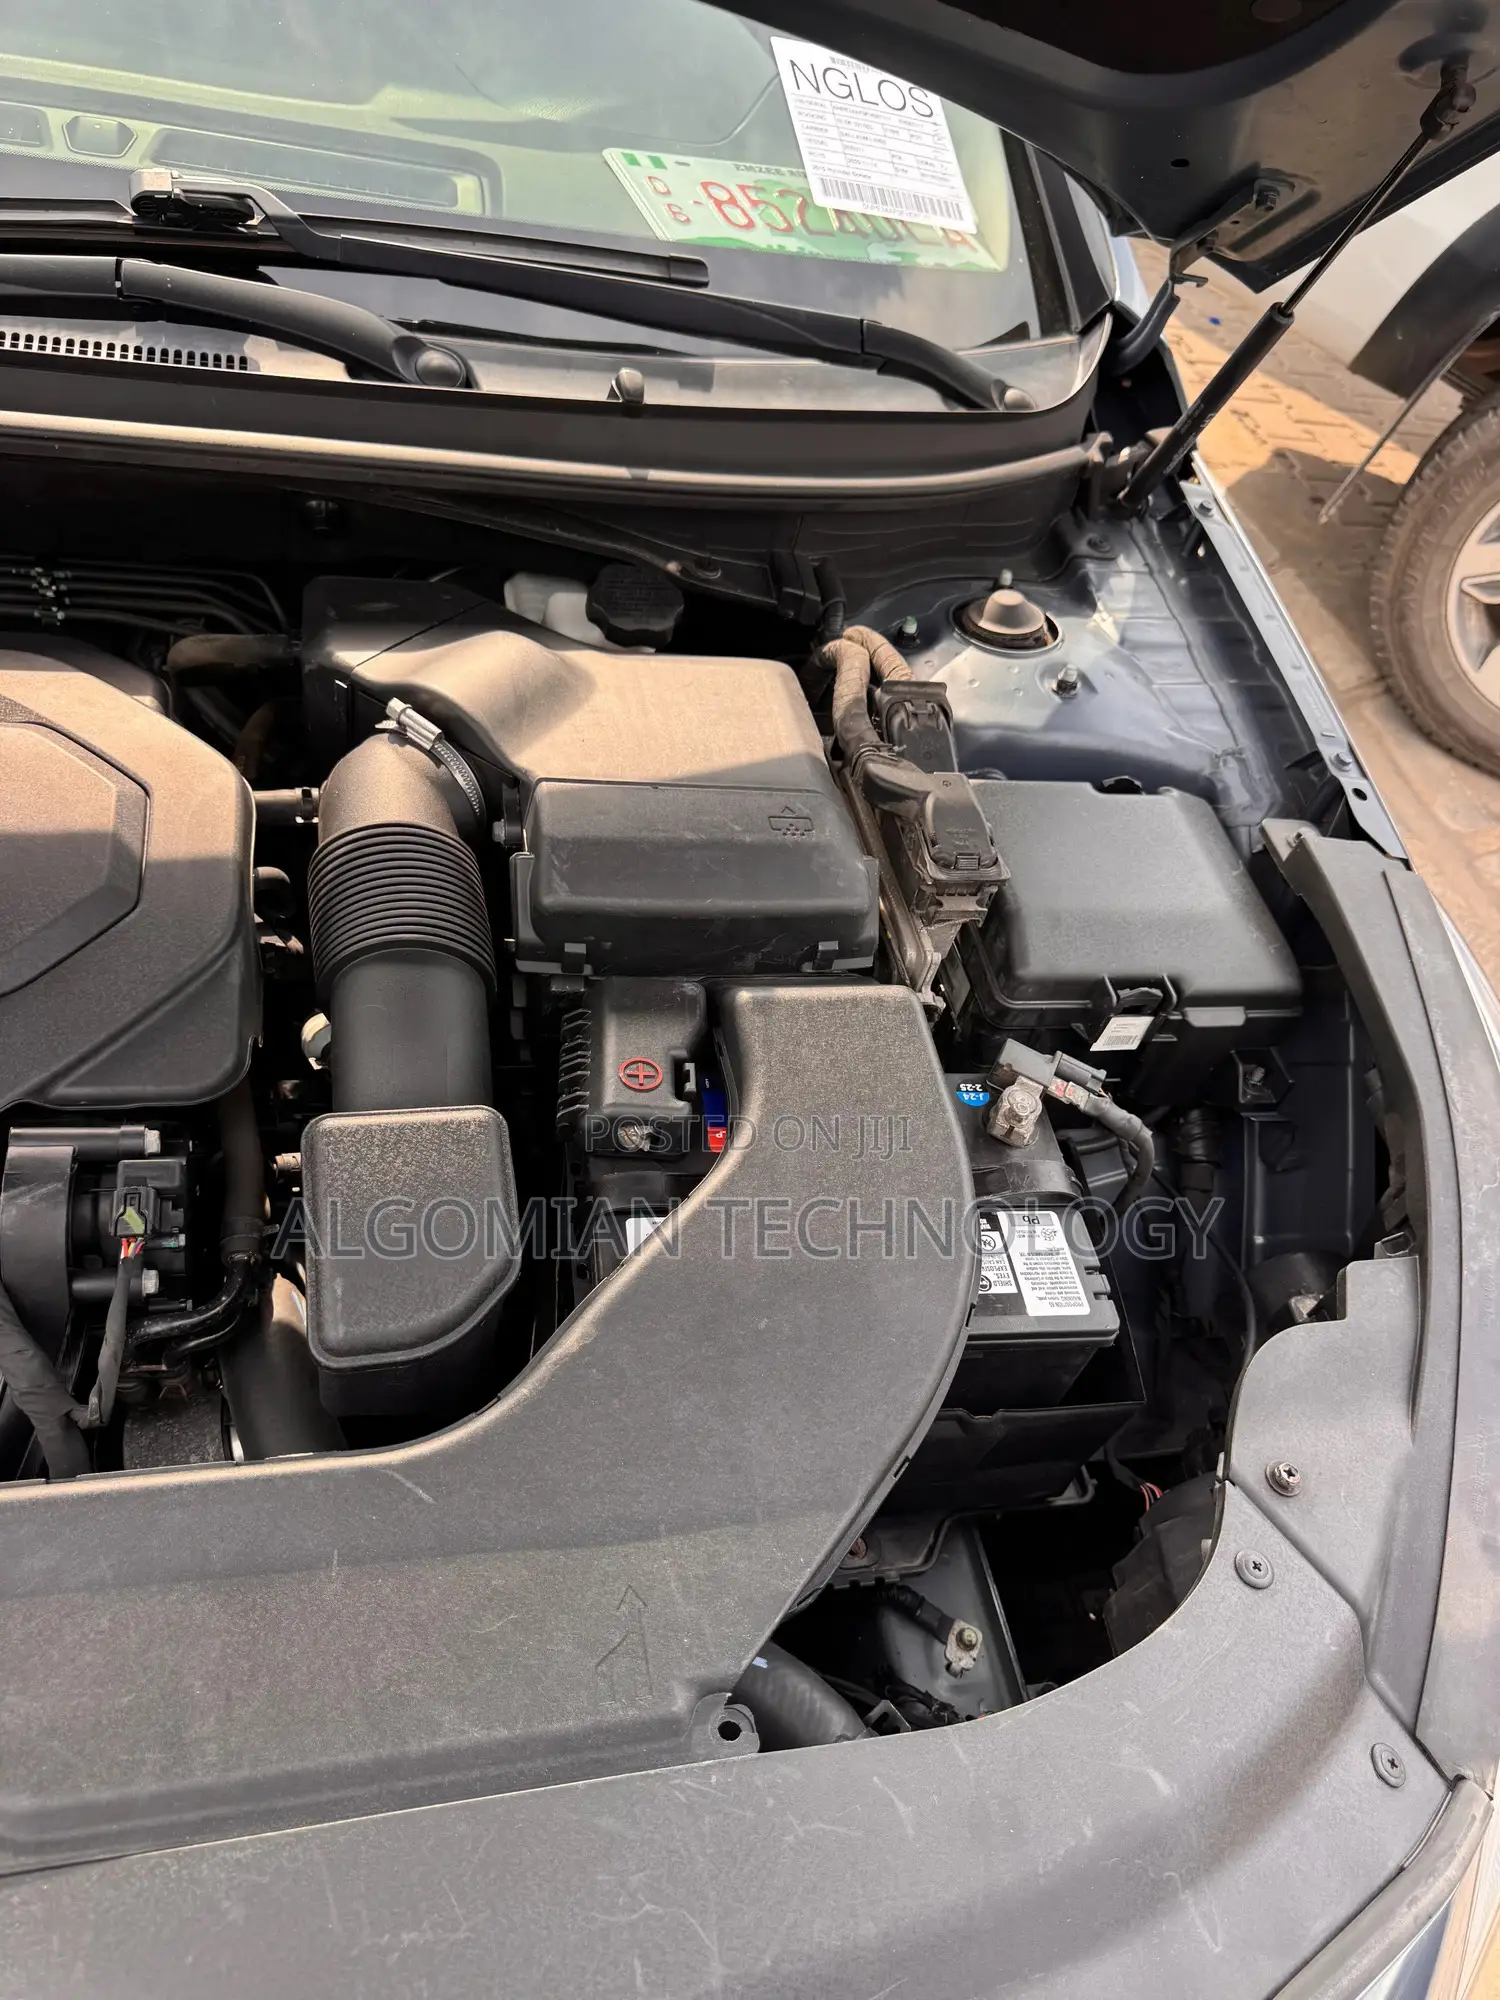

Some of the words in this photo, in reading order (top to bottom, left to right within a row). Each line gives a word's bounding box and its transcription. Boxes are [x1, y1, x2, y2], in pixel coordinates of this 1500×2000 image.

[789, 58, 933, 118] NGLOS
[959, 1083, 983, 1092] 2-25
[1022, 1215, 1041, 1225] Pb
